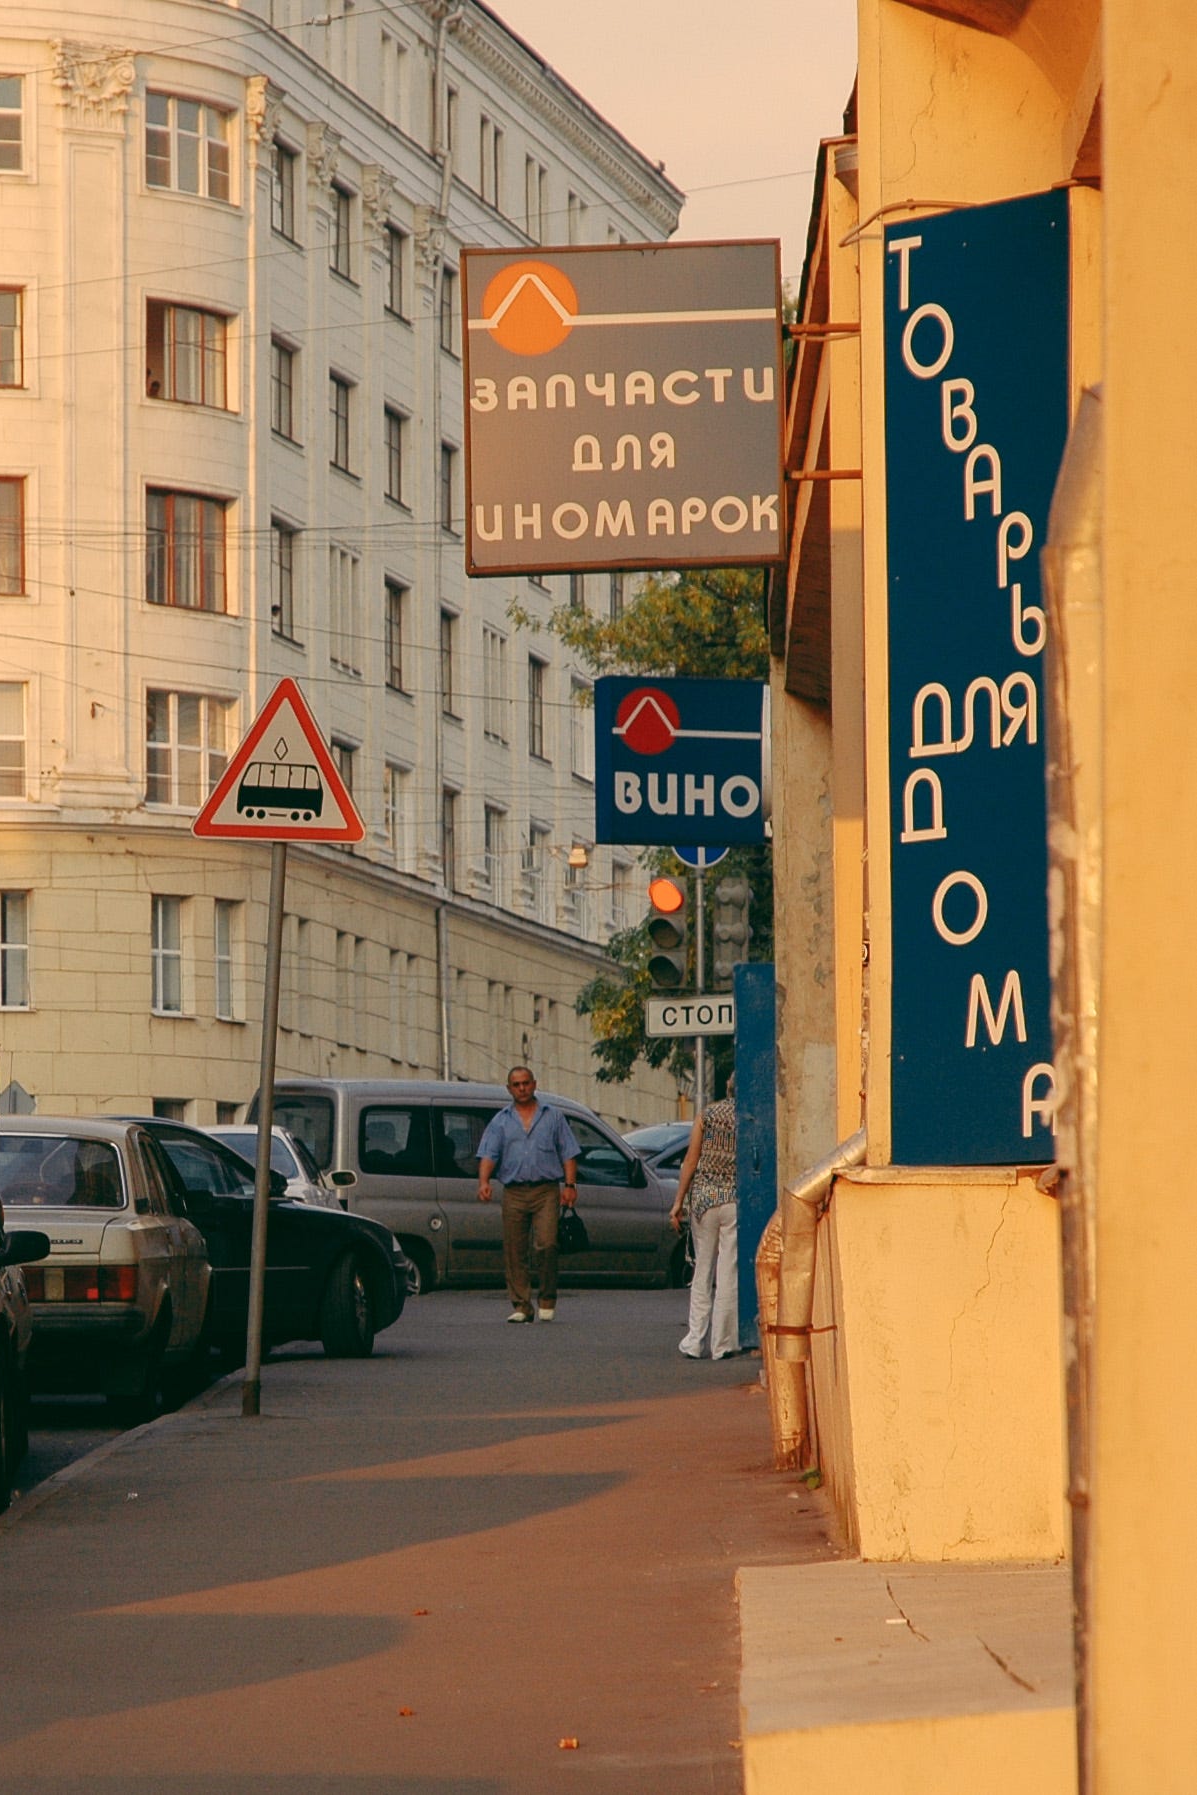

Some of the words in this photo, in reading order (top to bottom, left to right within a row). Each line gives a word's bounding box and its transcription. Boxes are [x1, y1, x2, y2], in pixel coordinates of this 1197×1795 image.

[470, 367, 775, 412] ЗАПЧАСТИ
[572, 431, 676, 471] ДЛЯ
[475, 494, 779, 541] ИНОМАРОК
[908, 670, 1037, 758] ДЛЯ
[614, 771, 760, 818] ВИНО
[662, 1005, 733, 1026] СТОП
